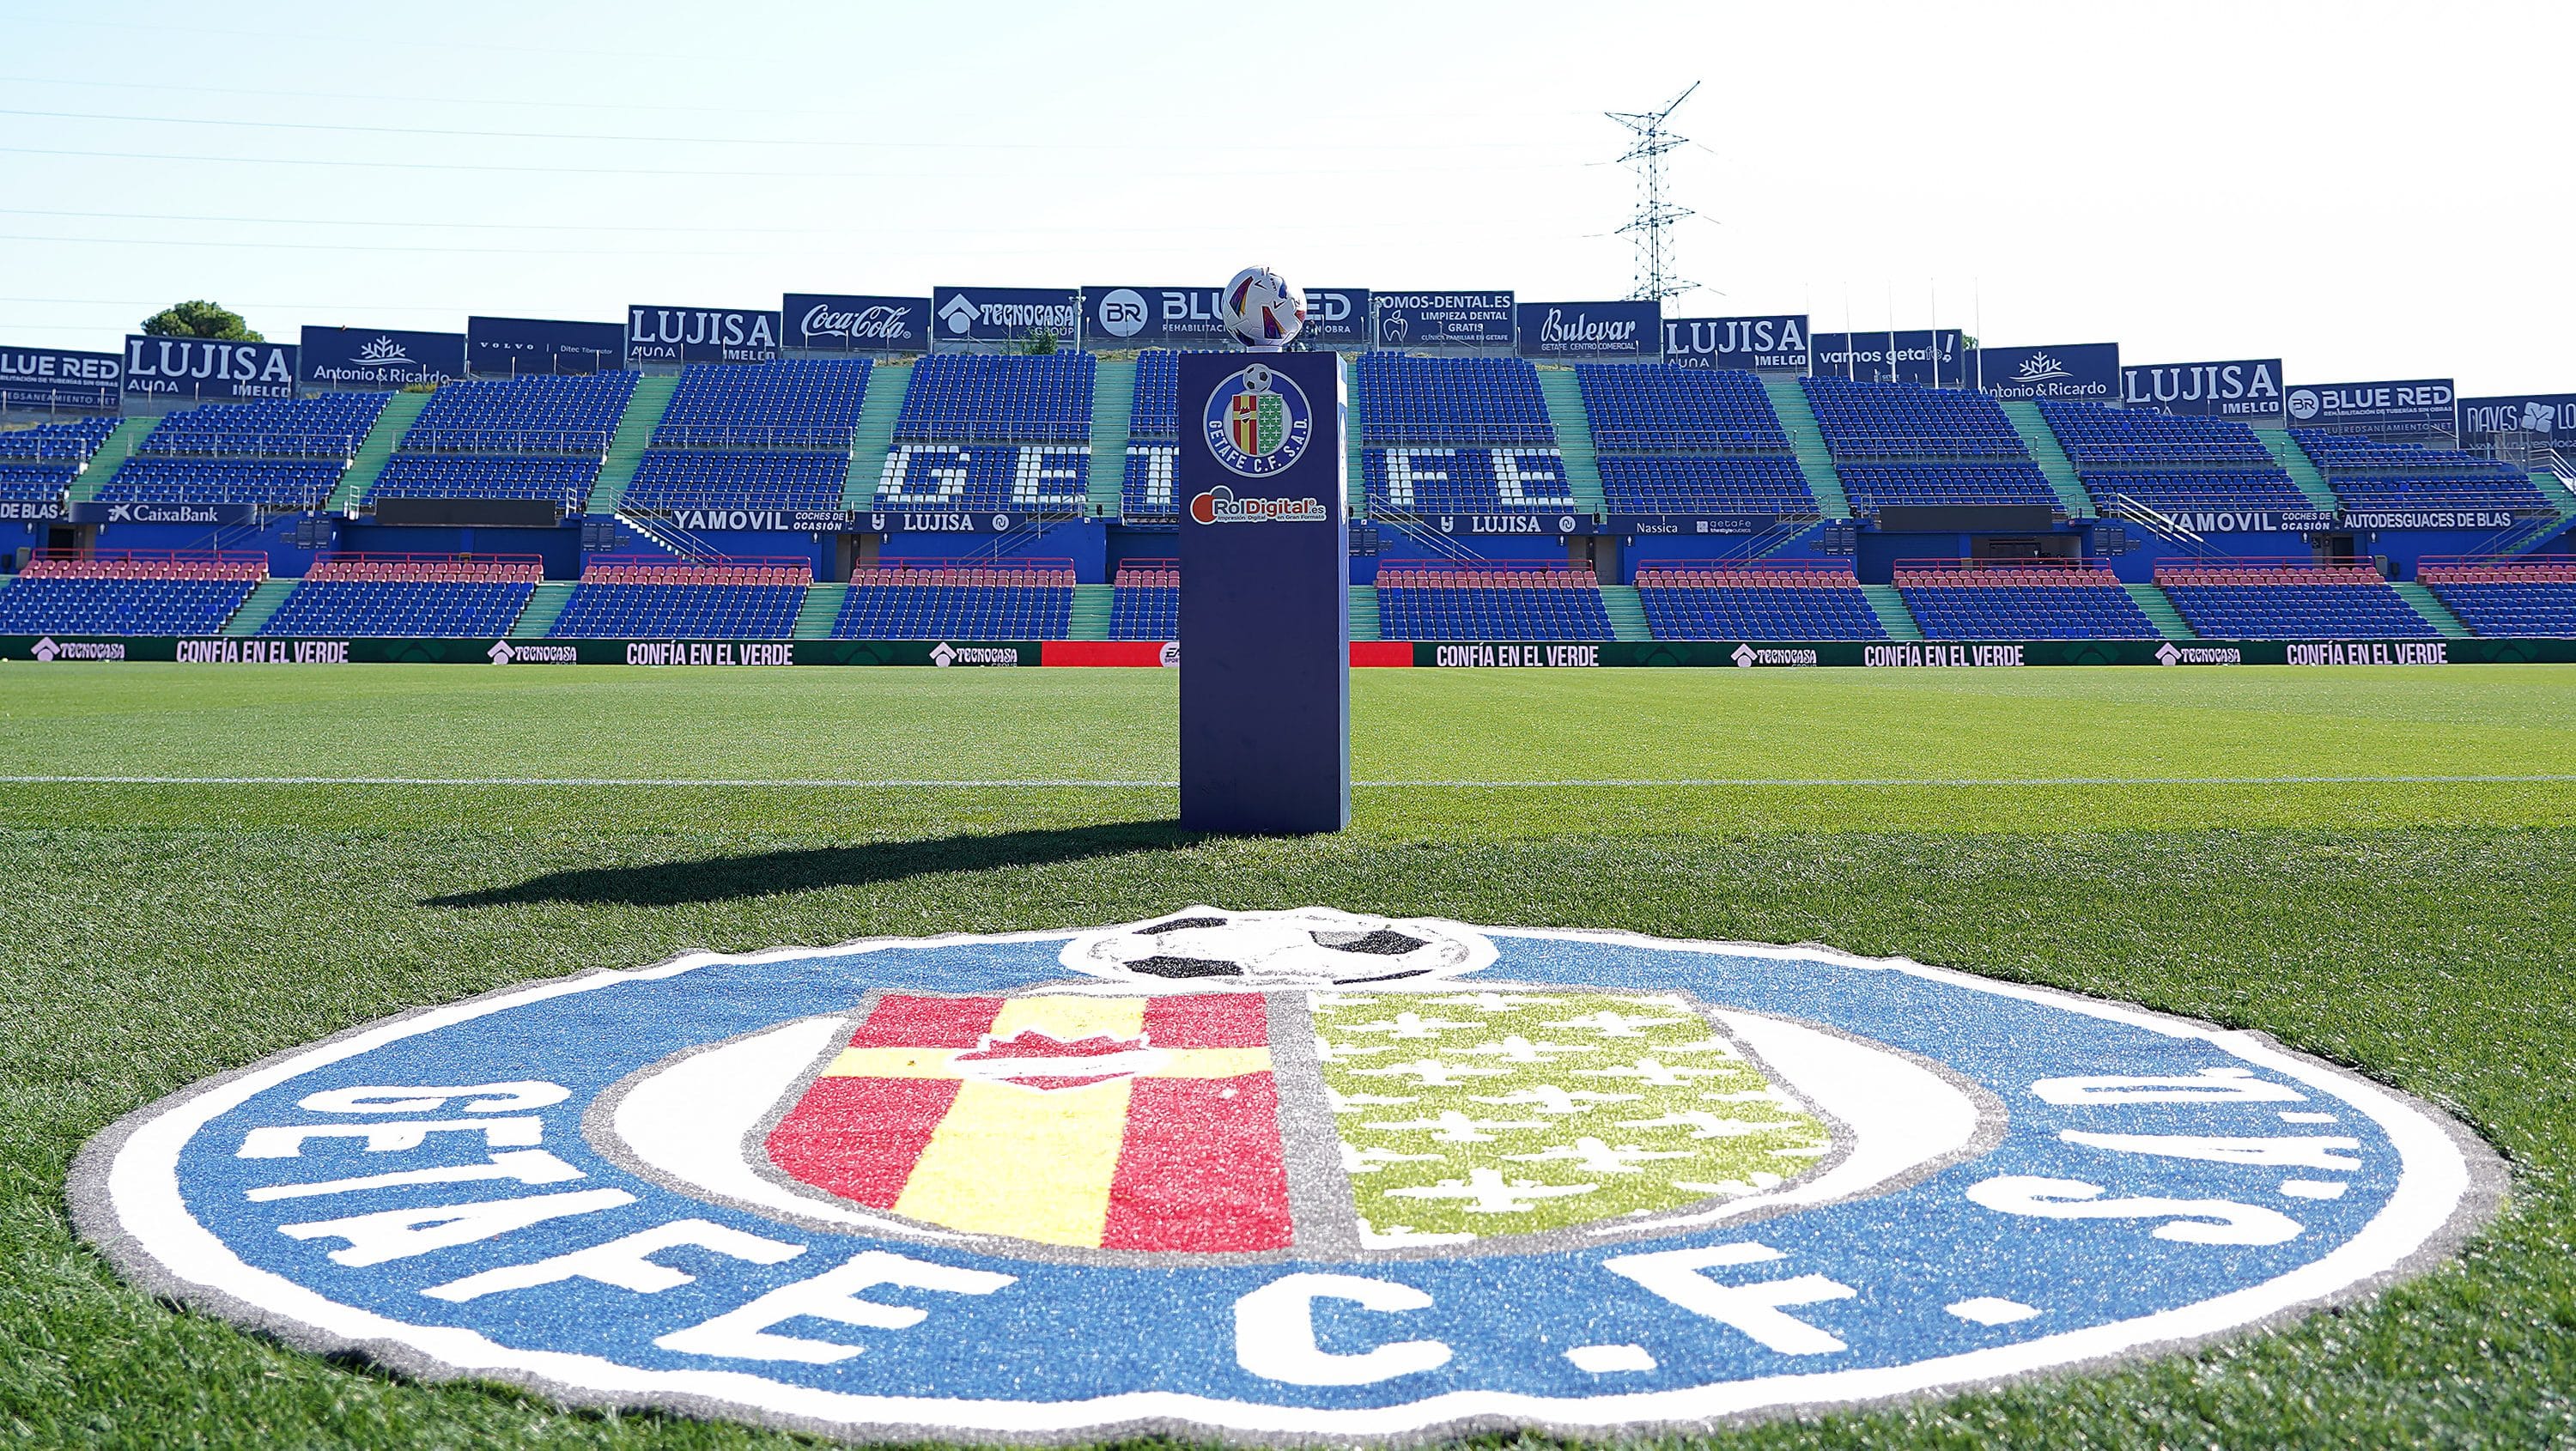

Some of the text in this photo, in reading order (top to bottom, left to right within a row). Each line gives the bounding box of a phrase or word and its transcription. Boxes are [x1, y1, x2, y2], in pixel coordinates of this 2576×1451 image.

[980, 303, 1074, 326] TECNOCASA
[1305, 294, 1352, 321] ED
[1421, 312, 1508, 320] LIMPIEZA DENTAL
[631, 310, 775, 347] LUJISA
[800, 304, 912, 338] Coca-Cola
[1448, 323, 1484, 332] GRATIS
[1540, 307, 1636, 343] Bulevar
[1666, 319, 1806, 355] LUJISA
[480, 342, 534, 351] VOLVO
[128, 340, 290, 383] LUJISA
[1755, 355, 1807, 366] IMELCO
[1820, 350, 1882, 363] vamos
[62, 357, 120, 379] RED
[313, 366, 373, 381] Antonio
[390, 367, 450, 384] Ricardo
[1980, 381, 2107, 398] Antonio & Ricardo
[2125, 364, 2279, 404] LUJISA
[2321, 389, 2391, 410] BLUE
[2397, 386, 2452, 406] RED
[2222, 401, 2279, 414] IMELCO
[2467, 404, 2576, 433] NAVES LO
[1208, 418, 1308, 472] GETAFE C.F. S.A.D.
[1, 503, 58, 519] DE BLAS
[133, 504, 219, 522] CaixaBank
[795, 512, 831, 520] COCHES
[673, 511, 789, 530] YAMOVIL
[793, 520, 842, 531] OCASIÓN
[903, 514, 975, 531] LUJISA
[1472, 516, 1542, 532] LUJISA
[1637, 517, 1678, 533] Nassica
[1710, 519, 1752, 528] getafe
[2161, 513, 2277, 531] YAMOVIL
[2281, 521, 2330, 531] OCASIÓN
[2344, 513, 2512, 528] AUTODESGUACES DE BLAS
[60, 642, 125, 659] TECNOCASA
[176, 638, 350, 664] CONFÍA EN EL VERDE
[514, 646, 577, 661] TECNOCASA
[626, 640, 794, 666] CONFÍA EN EL VERDE
[957, 648, 1018, 663] TECNOCASA
[1436, 642, 1600, 667] CONFÍA EN EL VERDE
[1757, 650, 1817, 664] TECNOCASA
[1863, 642, 2026, 667] CONFÍA EN EL VERDE
[2181, 648, 2241, 663] TECNOCASA
[2286, 640, 2448, 666] CONFÍA EN EL VERDE
[235, 1078, 1019, 1365] GETAFE
